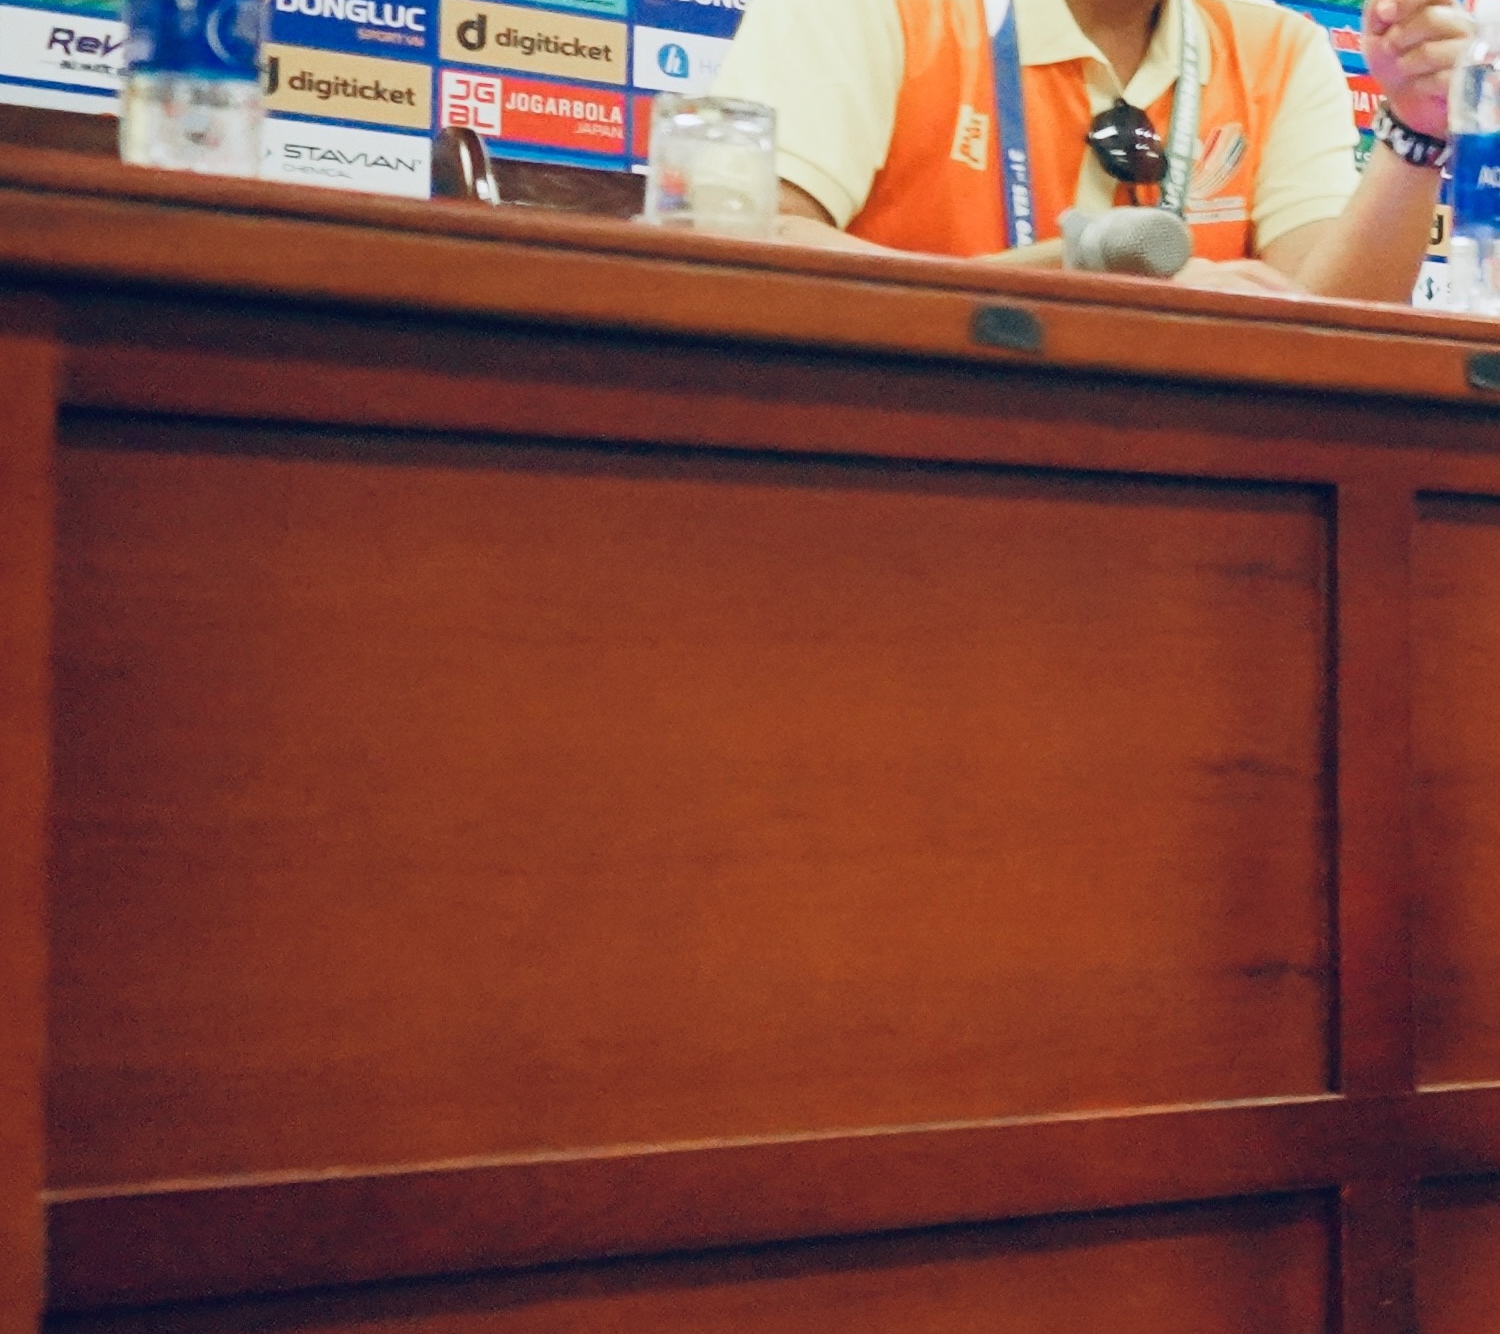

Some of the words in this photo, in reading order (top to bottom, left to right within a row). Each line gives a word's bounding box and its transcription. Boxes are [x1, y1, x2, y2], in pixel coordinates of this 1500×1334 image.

[495, 27, 613, 61] digiticket
[288, 70, 416, 105] digiticket
[504, 90, 623, 124] JOGARBOLA
